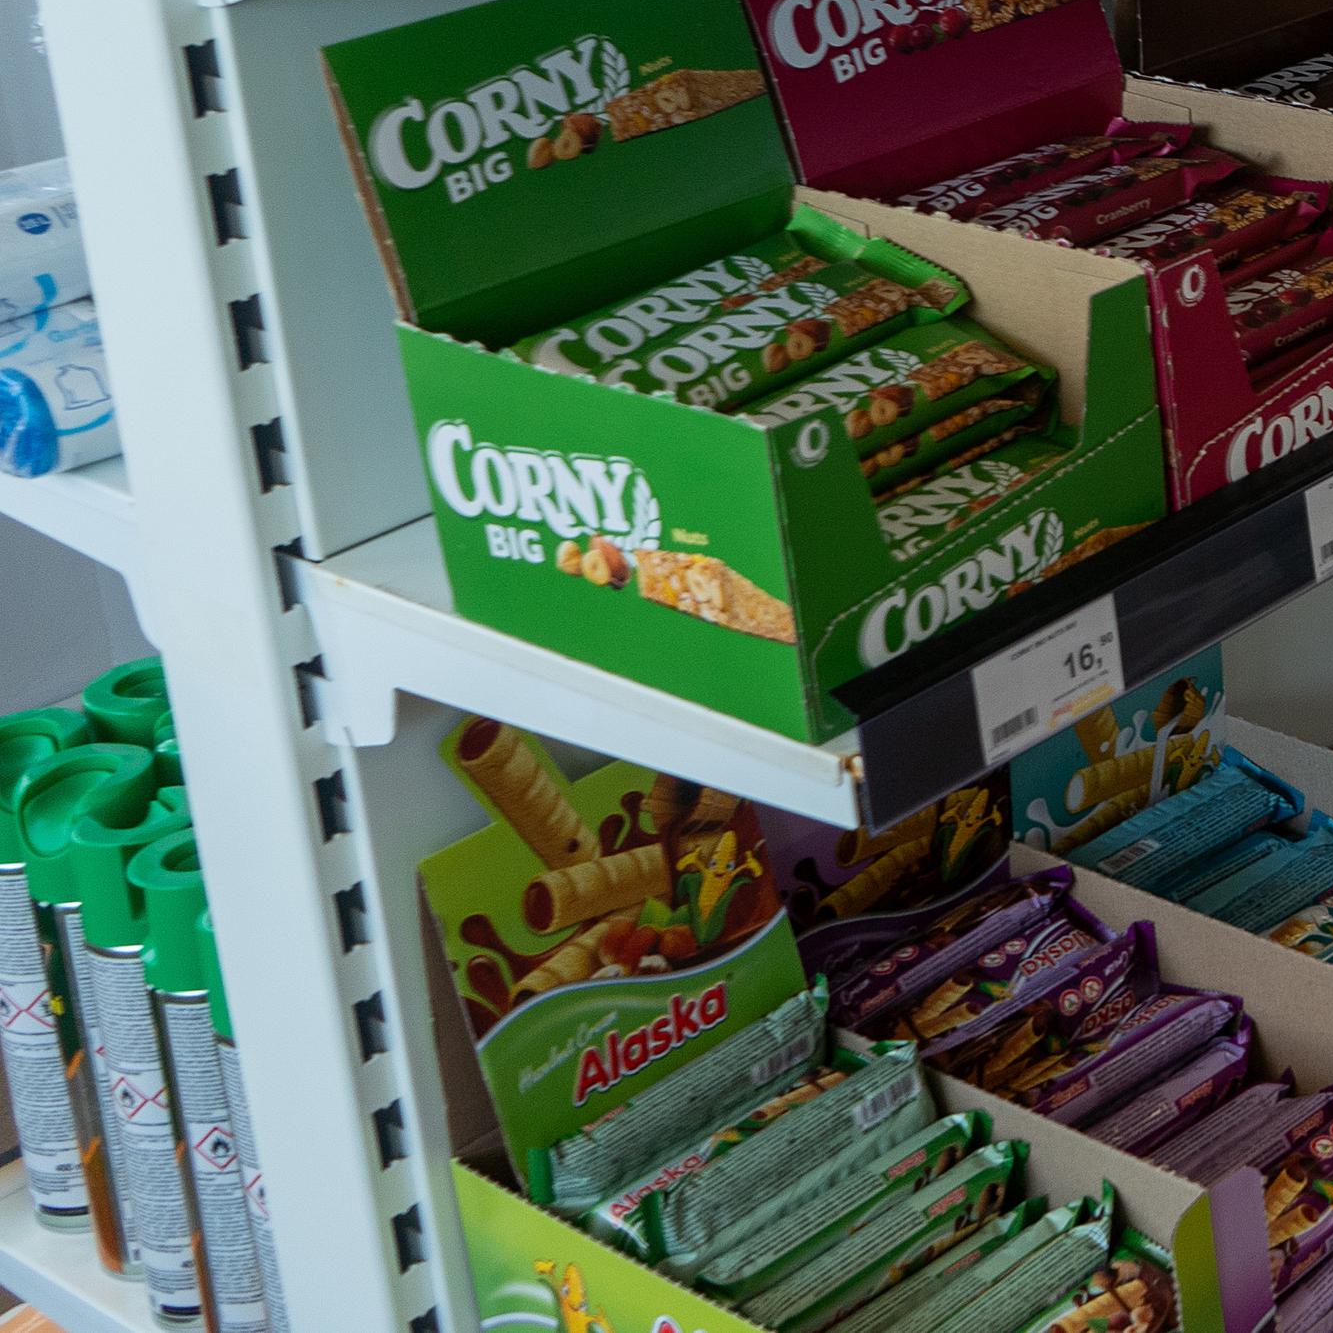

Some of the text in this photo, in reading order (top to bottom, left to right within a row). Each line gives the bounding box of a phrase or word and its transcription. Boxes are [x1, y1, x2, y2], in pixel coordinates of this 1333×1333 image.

[829, 34, 889, 84] BIG
[368, 32, 608, 190] CORNY
[443, 151, 514, 204] BIG
[926, 179, 984, 213] BIG
[1095, 198, 1152, 225] Cranberry
[1274, 317, 1328, 348] Cranberry
[688, 362, 752, 409] BIG
[427, 418, 636, 540] CORNY
[878, 462, 1008, 541] RNY
[483, 522, 546, 565] BIG
[670, 525, 710, 546] Nuts
[859, 510, 1050, 669] CORNY
[1063, 642, 1103, 679] 16,
[572, 979, 729, 1109] Alaska
